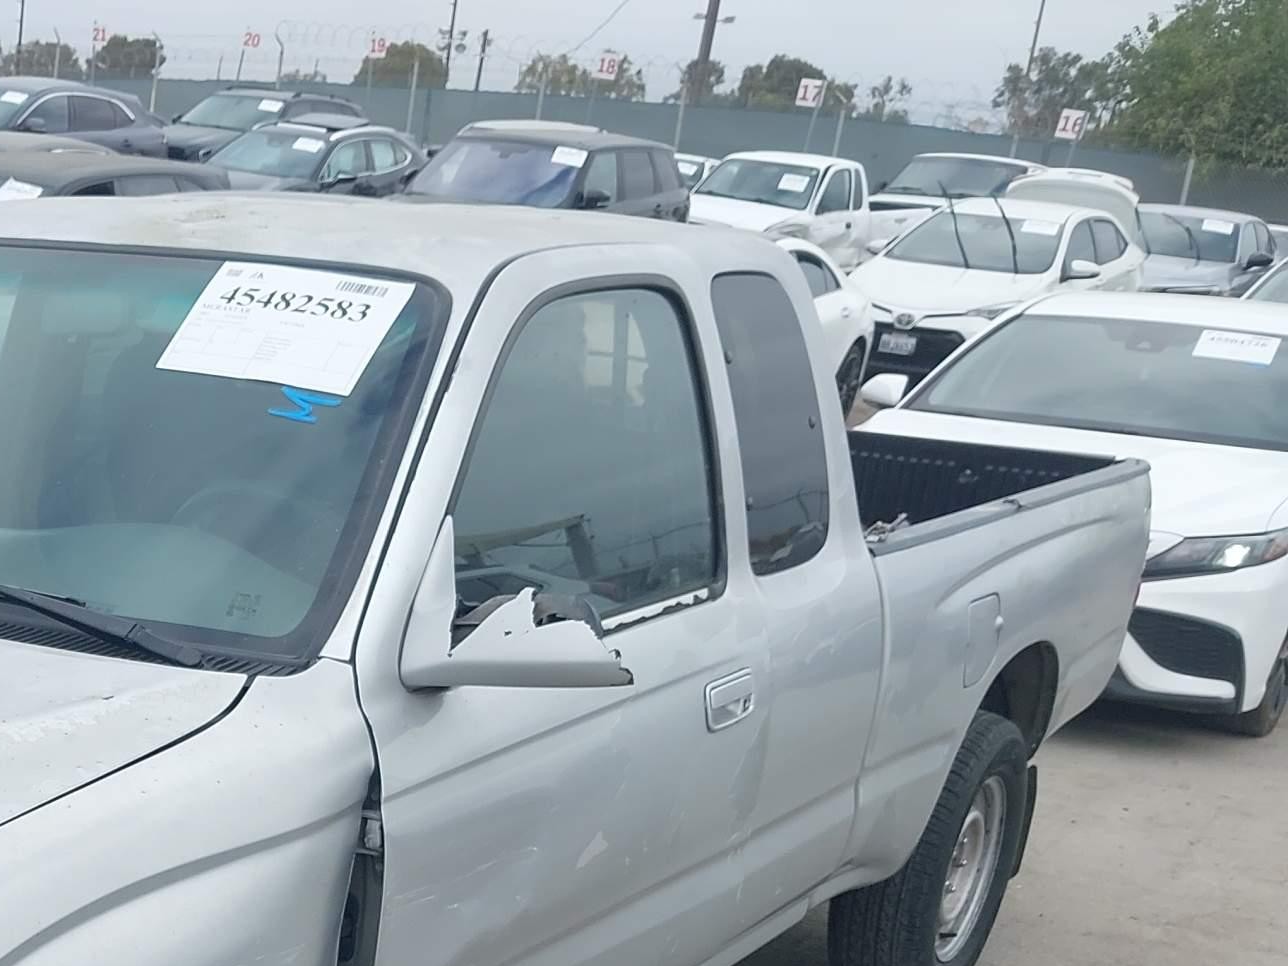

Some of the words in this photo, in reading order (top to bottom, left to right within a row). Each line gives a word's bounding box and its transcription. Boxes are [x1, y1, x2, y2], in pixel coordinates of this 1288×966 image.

[92, 27, 106, 42] 21
[243, 31, 261, 48] 20
[370, 38, 386, 53] 19
[598, 57, 617, 74] 18
[799, 84, 823, 102] 17
[1058, 115, 1082, 135] 16
[219, 285, 372, 322] 45482583
